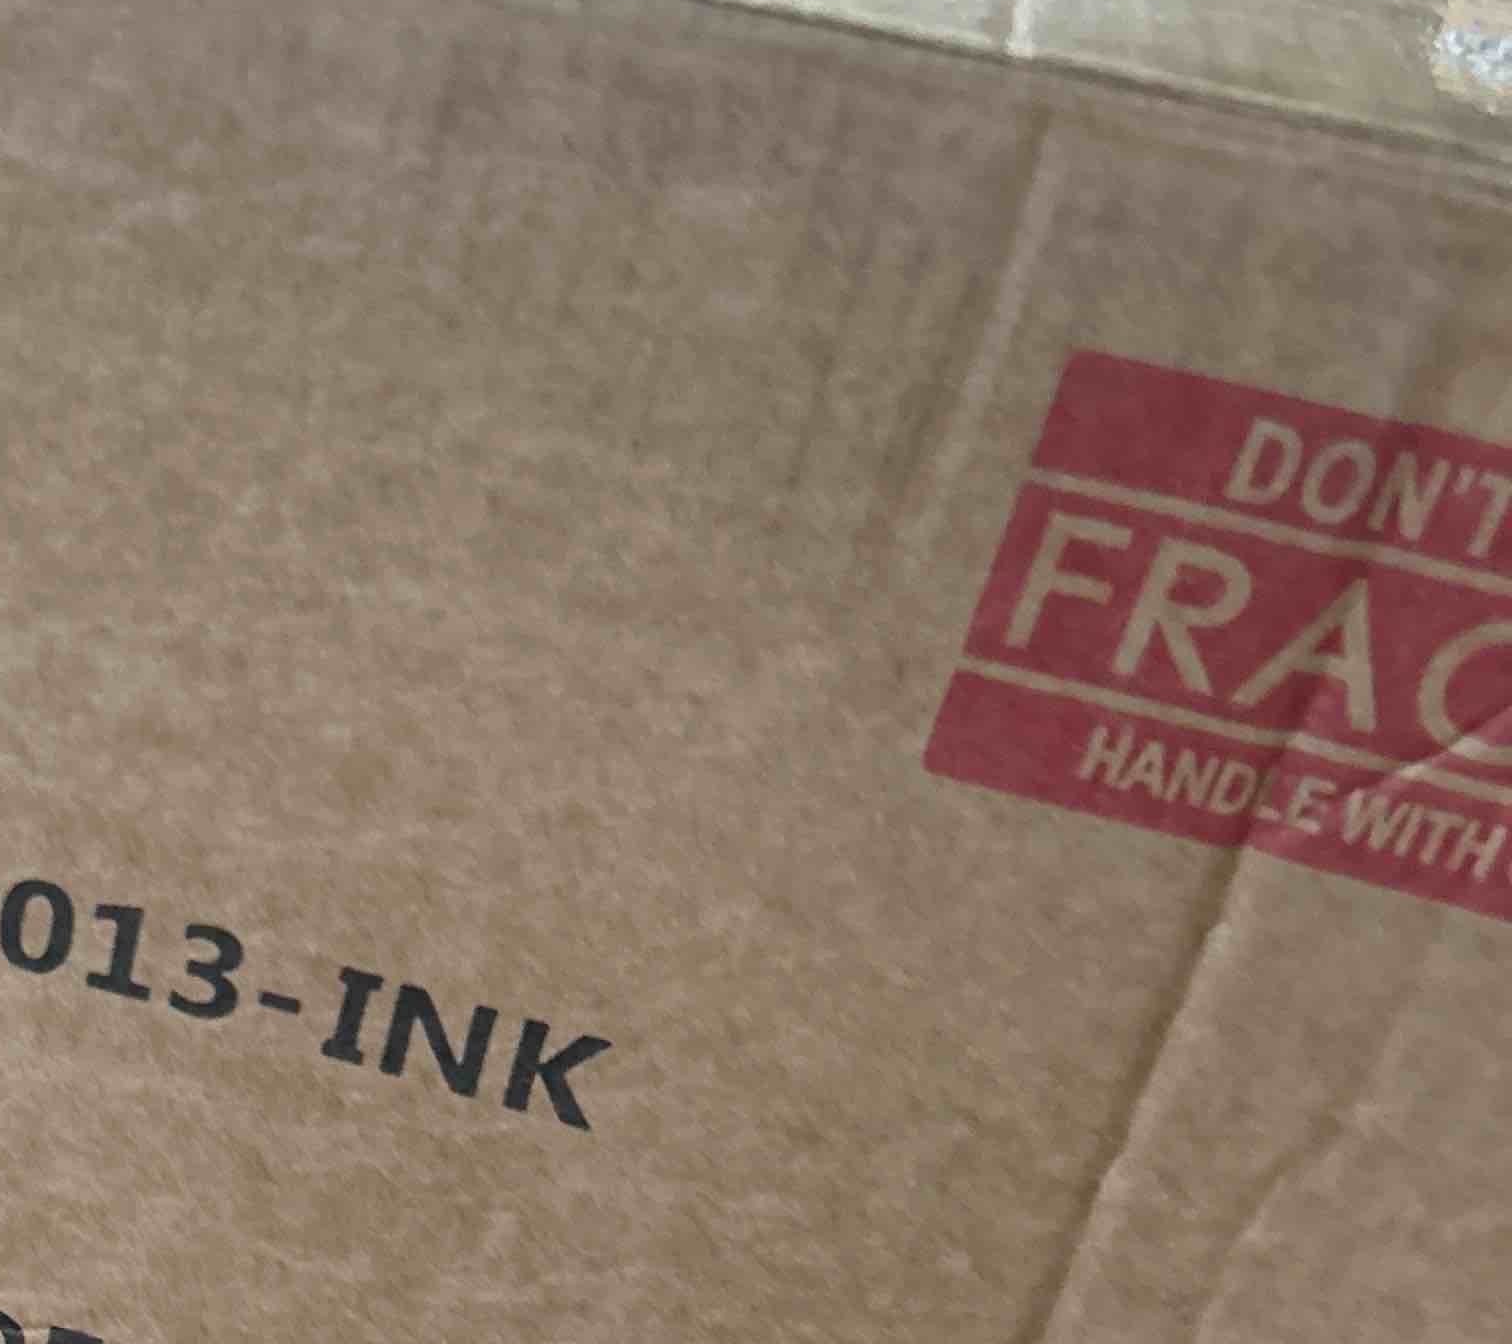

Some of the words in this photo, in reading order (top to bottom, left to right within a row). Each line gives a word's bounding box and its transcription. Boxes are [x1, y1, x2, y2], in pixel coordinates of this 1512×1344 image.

[1223, 417, 1512, 557] DON'T
[1078, 724, 1338, 834] HANDLE
[1338, 790, 1508, 883] WITH
